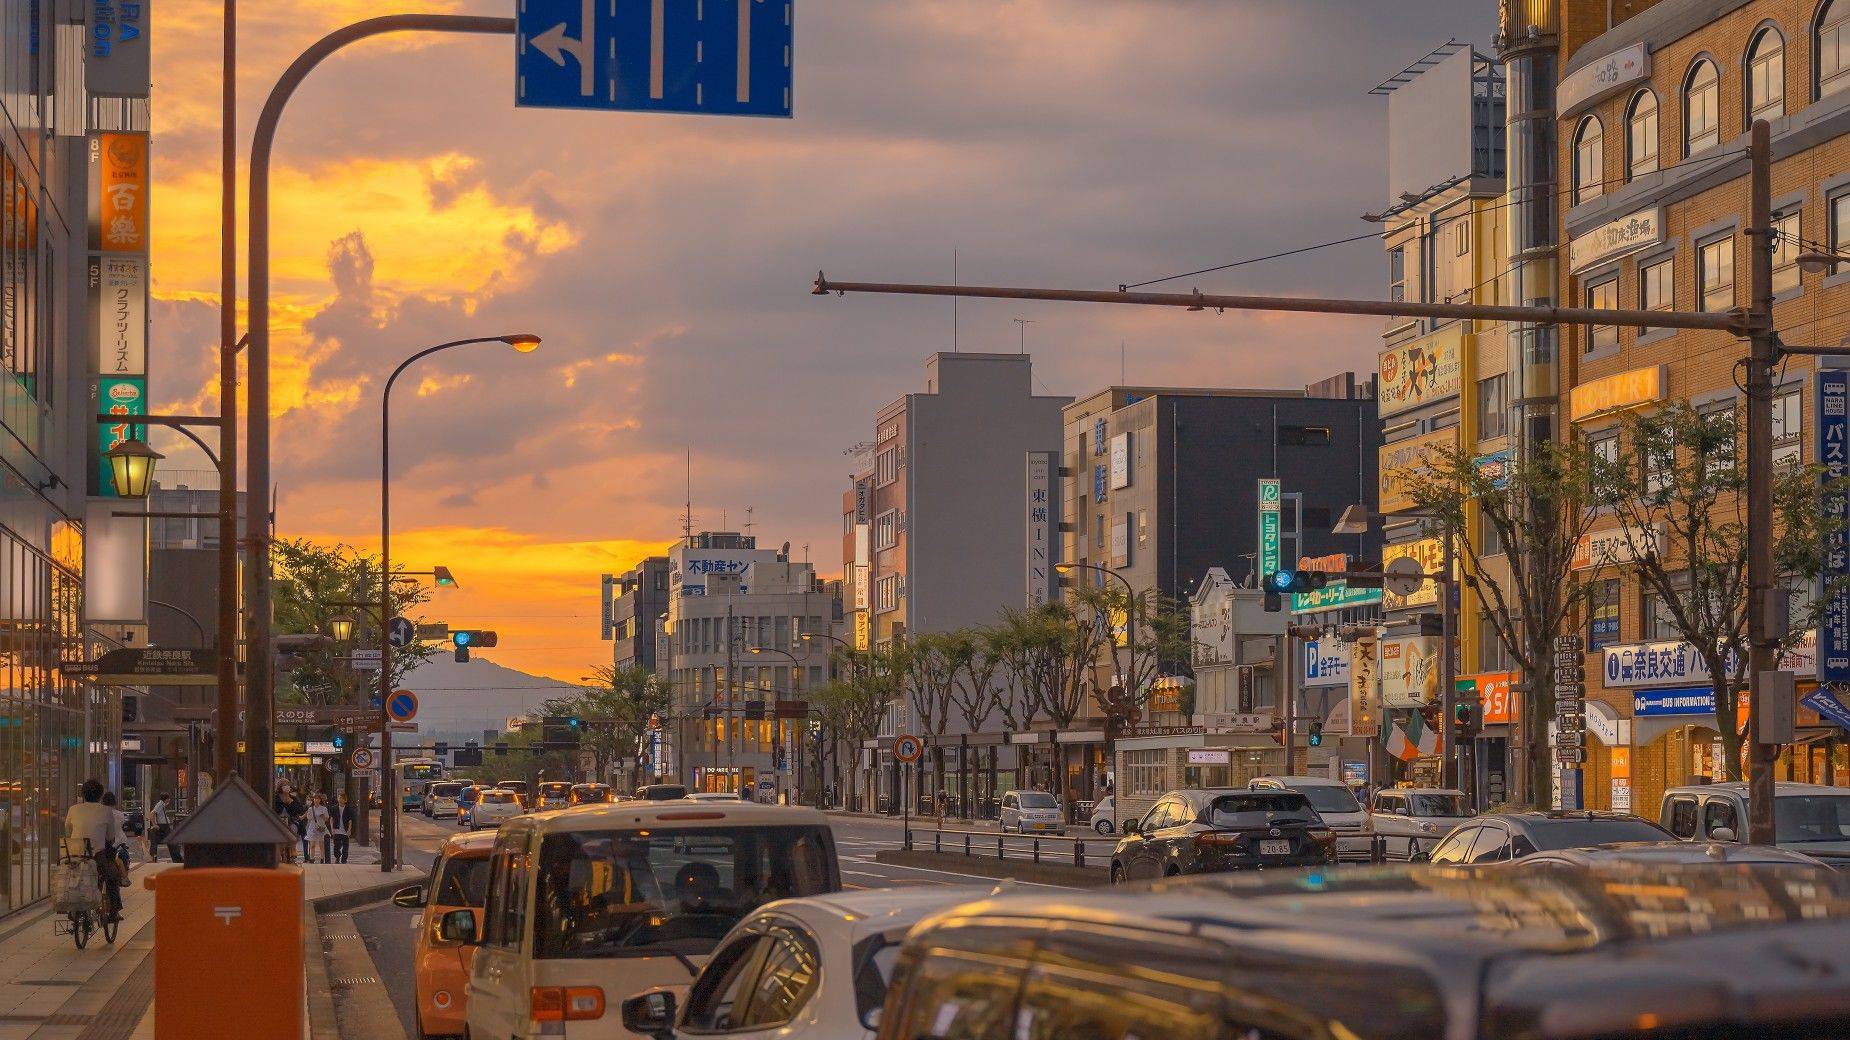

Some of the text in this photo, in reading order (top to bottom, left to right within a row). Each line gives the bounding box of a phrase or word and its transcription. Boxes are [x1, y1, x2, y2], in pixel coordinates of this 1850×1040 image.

[91, 139, 100, 162] 8F
[116, 288, 129, 372] クラブツーリズム
[858, 621, 867, 649] アイフル
[1634, 647, 1685, 680] 奈良交通
[1662, 698, 1673, 708] BUS
[1674, 696, 1710, 707] INFORMATION
